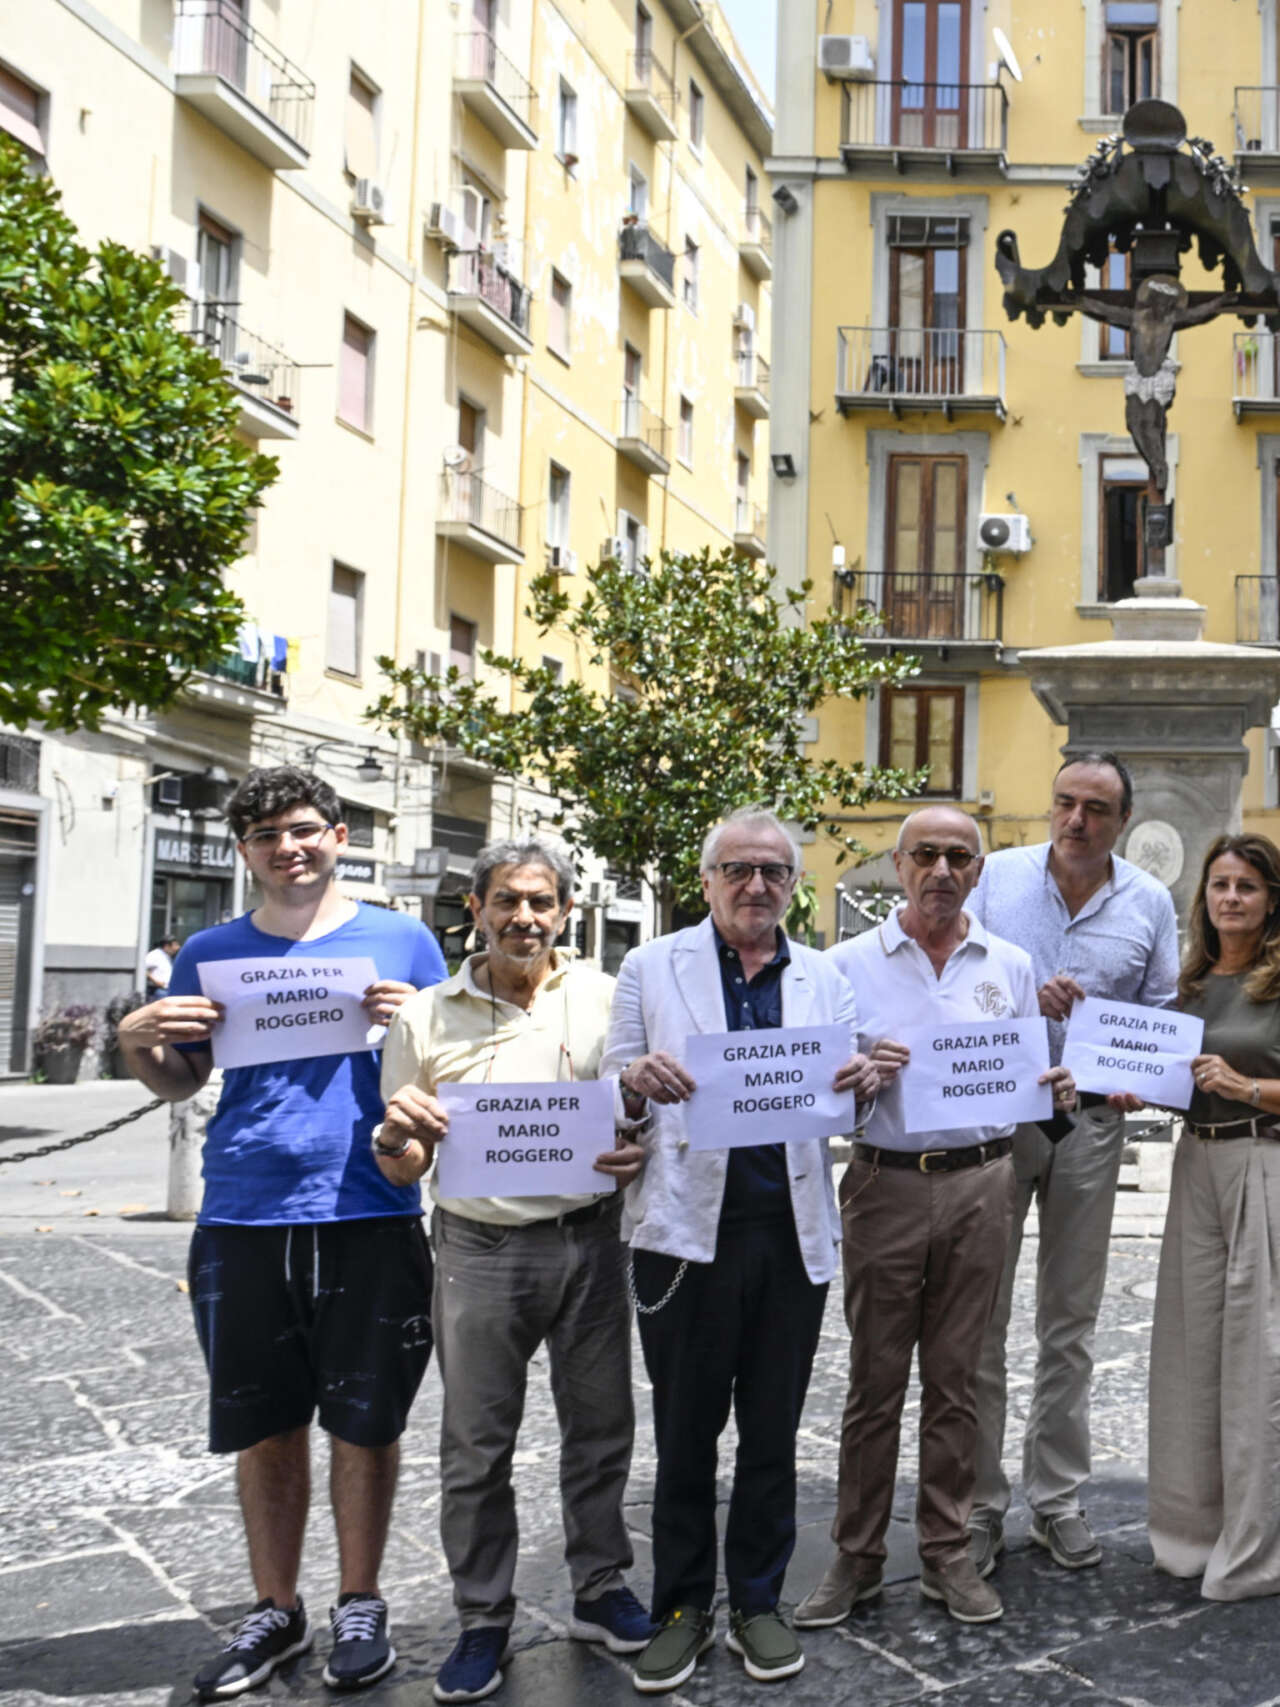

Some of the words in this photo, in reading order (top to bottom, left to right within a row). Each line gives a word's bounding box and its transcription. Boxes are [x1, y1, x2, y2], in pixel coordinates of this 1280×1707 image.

[157, 839, 234, 868] MARSELLA
[240, 968, 307, 984] GRAZIA
[312, 967, 344, 978] PER
[266, 987, 329, 1006] MARIO
[255, 1008, 344, 1031] ROGGERO
[1099, 1013, 1148, 1031] GRAZIA
[1152, 1022, 1177, 1036] PER
[723, 1044, 789, 1062] GRAZIA
[791, 1041, 822, 1057] PER
[932, 1035, 989, 1052] GRAZIA
[992, 1032, 1020, 1047] PER
[1110, 1037, 1159, 1054] MARIO
[951, 1057, 1005, 1075] MARIO
[1096, 1055, 1165, 1076] ROGGERO
[744, 1069, 804, 1088] MARIO
[942, 1079, 1017, 1099] ROGGERO
[476, 1097, 543, 1113] GRAZIA
[547, 1096, 580, 1111] PER
[733, 1093, 816, 1113] ROGGERO
[498, 1123, 561, 1138] MARIO
[485, 1147, 574, 1164] ROGGERO
